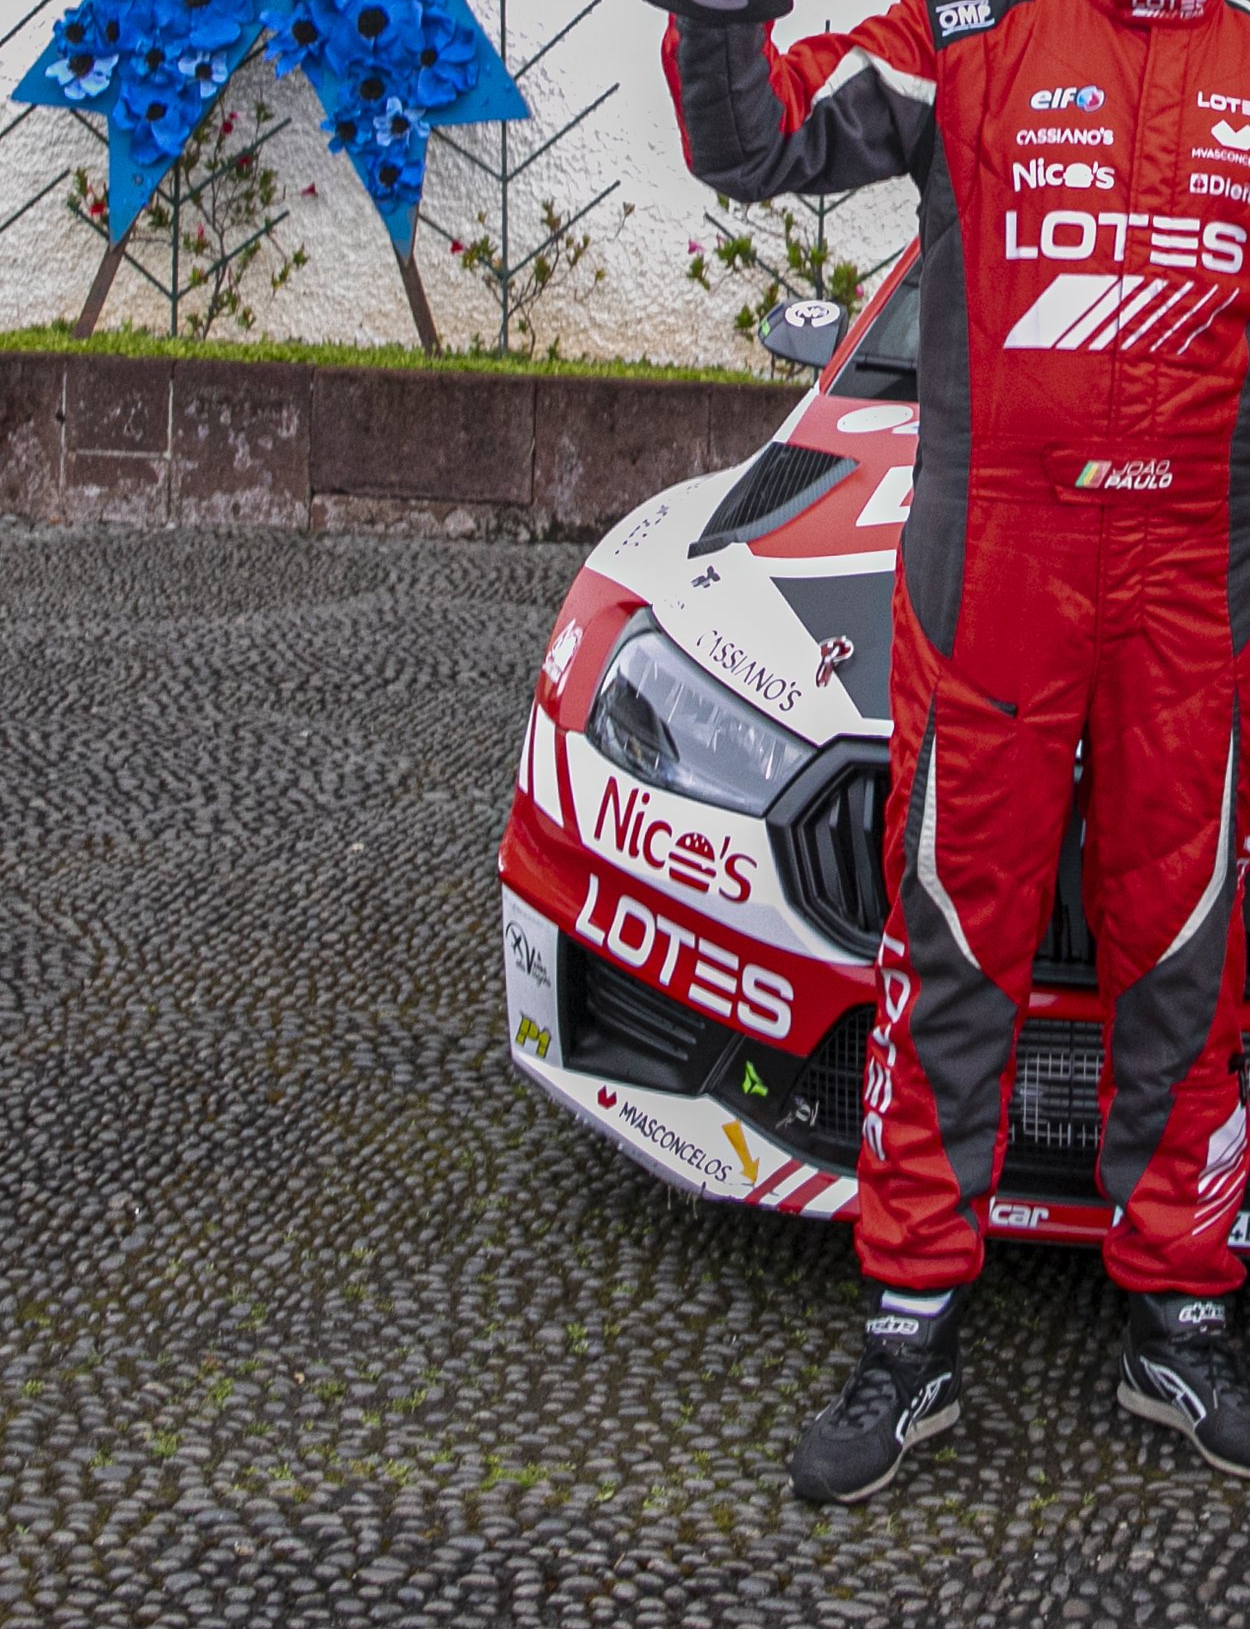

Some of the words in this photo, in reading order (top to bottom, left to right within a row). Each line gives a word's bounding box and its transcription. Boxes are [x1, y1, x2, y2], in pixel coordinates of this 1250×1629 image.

[937, 0, 994, 33] OMP
[1016, 127, 1115, 147] CASSIANO'S
[1005, 210, 1248, 274] LOTES
[1104, 473, 1173, 490] PAULO
[575, 872, 795, 1040] LOTES
[618, 1101, 733, 1183] MVASCONCELOS
